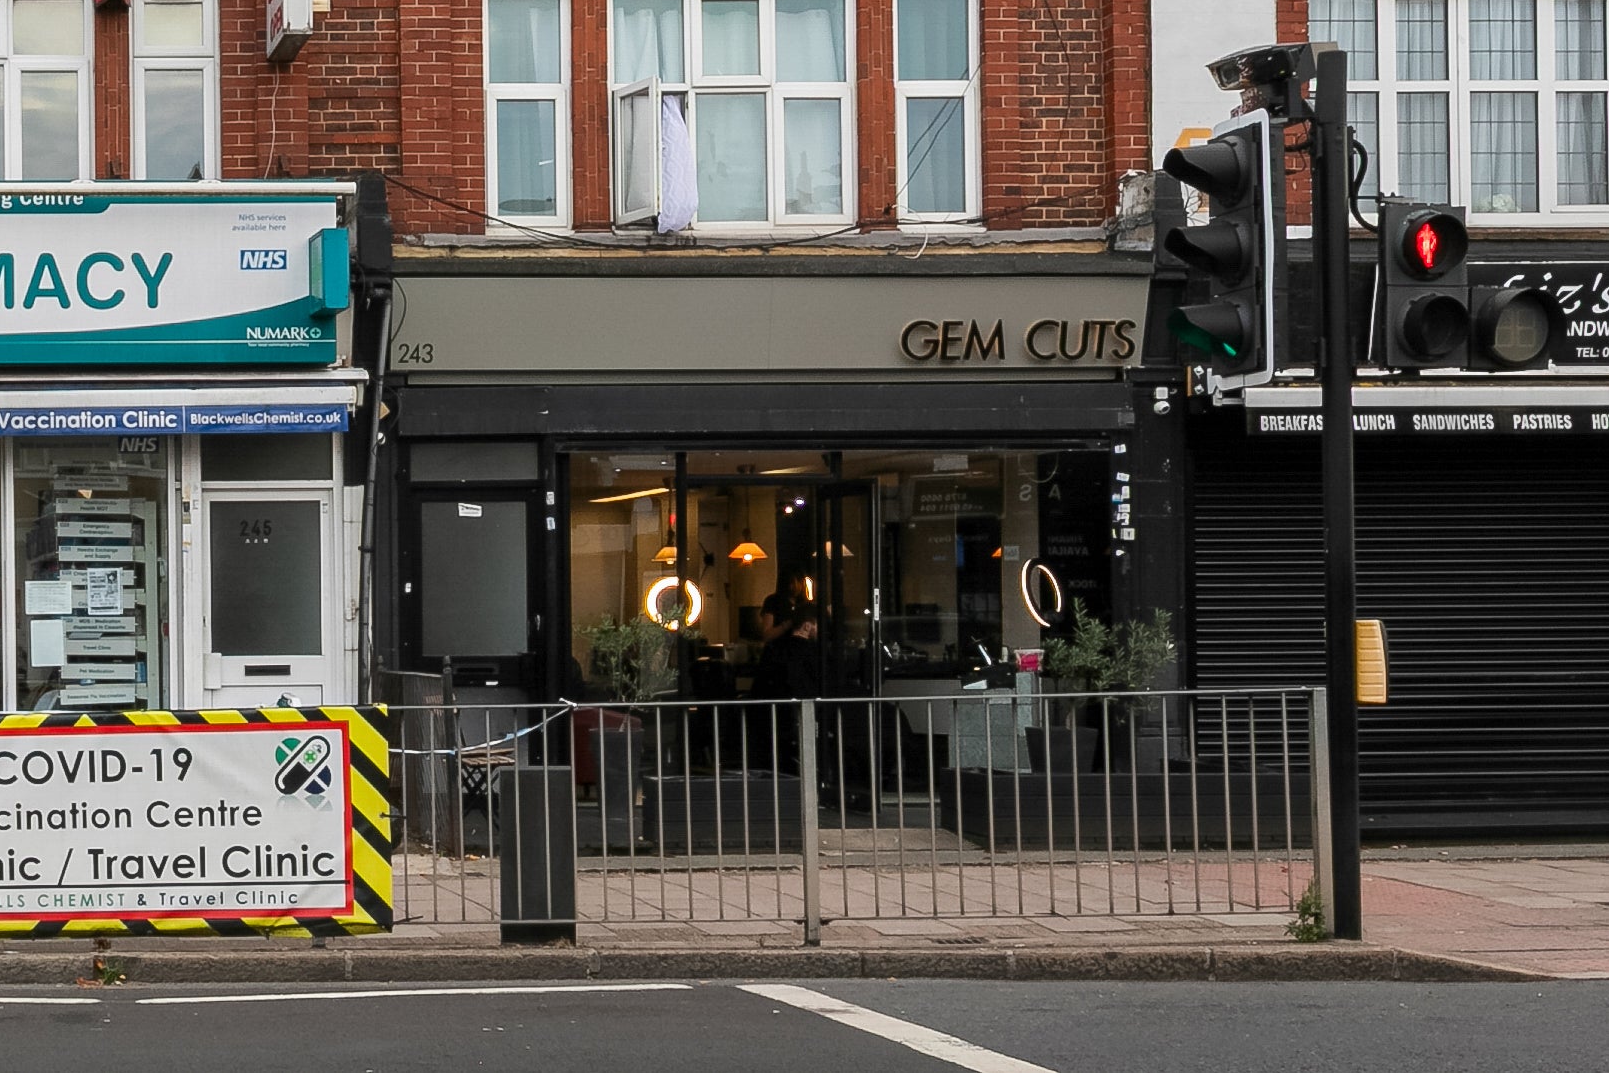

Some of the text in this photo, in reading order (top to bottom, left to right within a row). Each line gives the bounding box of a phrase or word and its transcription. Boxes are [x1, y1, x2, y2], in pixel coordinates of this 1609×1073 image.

[232, 223, 286, 231] available here
[242, 251, 285, 268] NHS
[247, 327, 309, 340] NUMARK
[900, 319, 1137, 361] GEM CUTS
[398, 343, 434, 364] 243
[1576, 347, 1600, 358] TEL:
[122, 410, 177, 429] Clinic
[190, 412, 341, 426] BlackwellsChemist.co.uk
[1260, 413, 1609, 431] BREAKFAS LUNCH SANDWICHES PASTRIES HO
[120, 437, 157, 452] NHS
[240, 518, 272, 537] 245
[145, 799, 263, 829] Centre
[87, 845, 207, 881] Travel
[221, 842, 336, 879] Clinic
[37, 892, 126, 908] CHEMIST
[137, 893, 147, 907] &
[159, 891, 225, 907] Travel
[235, 890, 299, 905] Clinic
